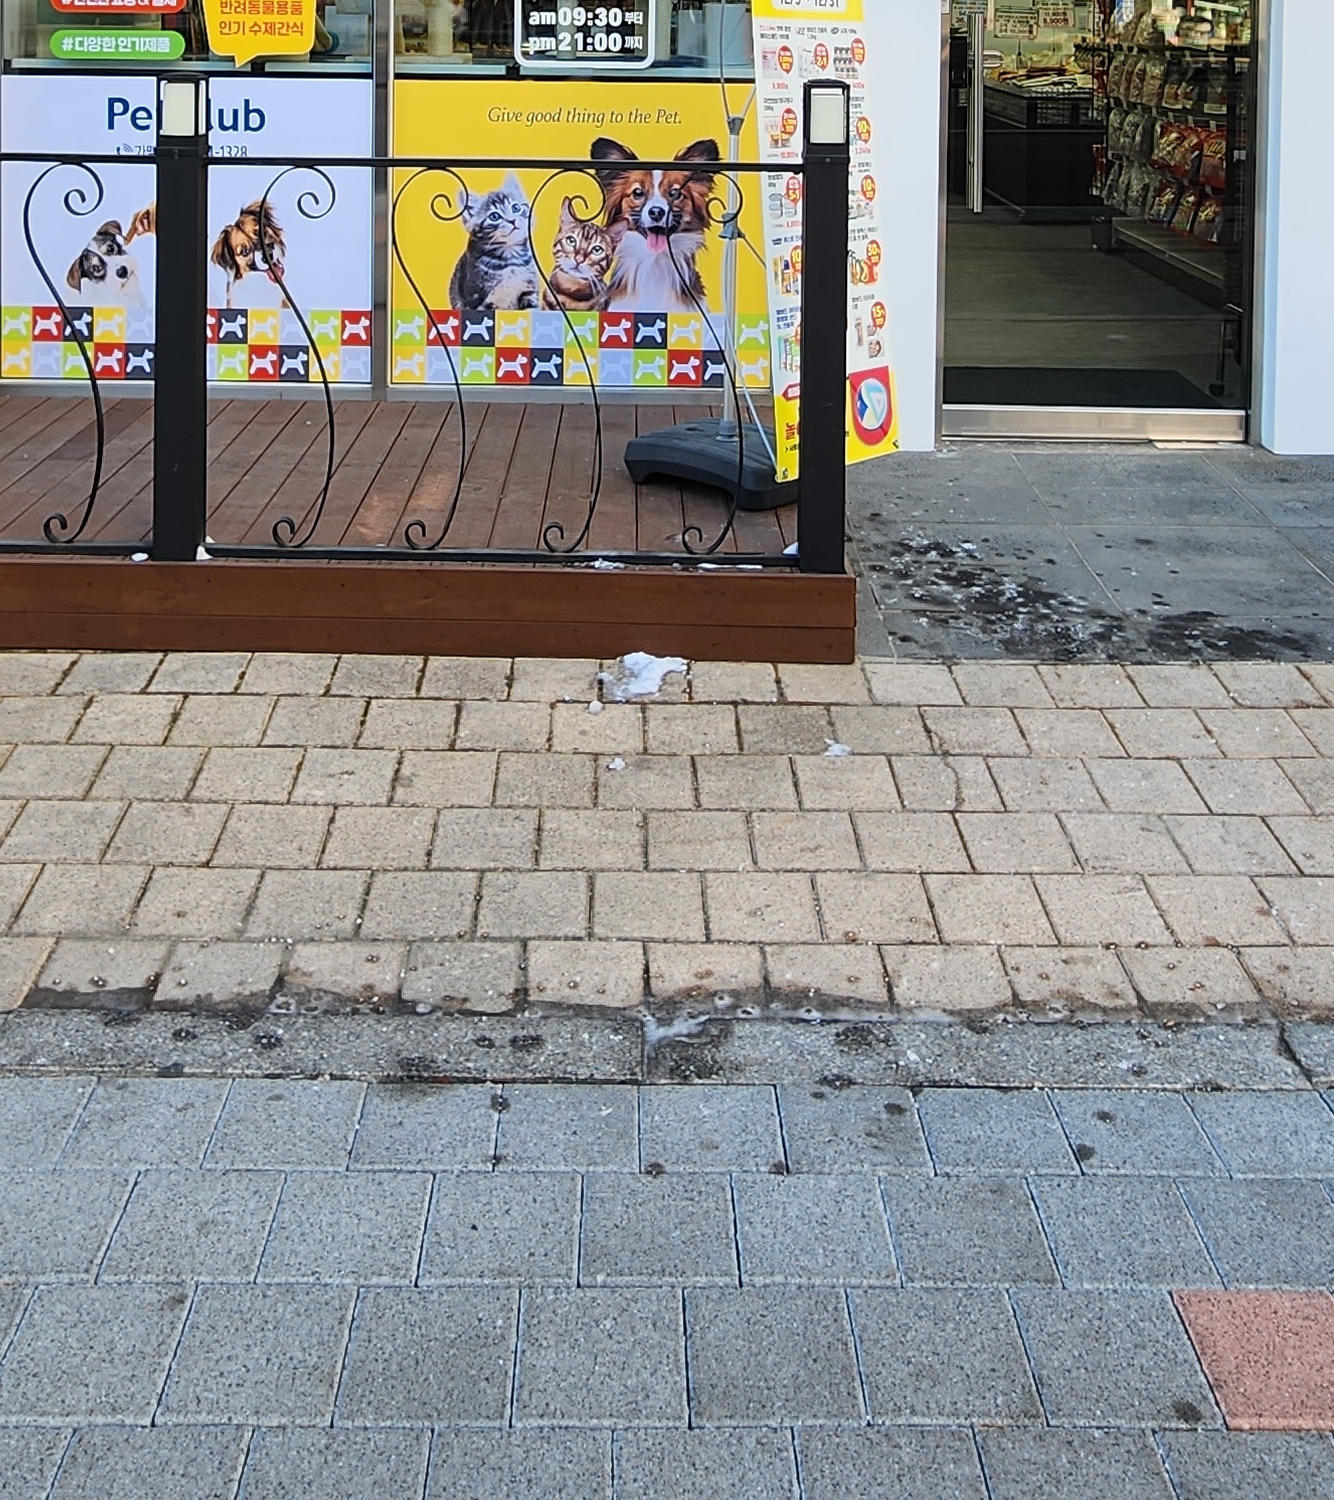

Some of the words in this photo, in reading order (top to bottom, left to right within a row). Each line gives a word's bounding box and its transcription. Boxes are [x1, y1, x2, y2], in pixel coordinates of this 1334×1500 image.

[219, 0, 304, 17] 반려동물용품
[624, 12, 644, 26] 부터
[219, 20, 247, 38] 인기
[247, 20, 305, 38] 수제간식
[61, 36, 116, 53] #다양한
[116, 36, 171, 53] 인기제품
[107, 97, 154, 132] Pe
[209, 98, 266, 133] lub
[487, 106, 524, 124] Give
[525, 108, 563, 128] good
[565, 107, 605, 128] thing
[609, 110, 624, 124] to
[627, 108, 652, 125] the
[654, 108, 683, 125] Pet.
